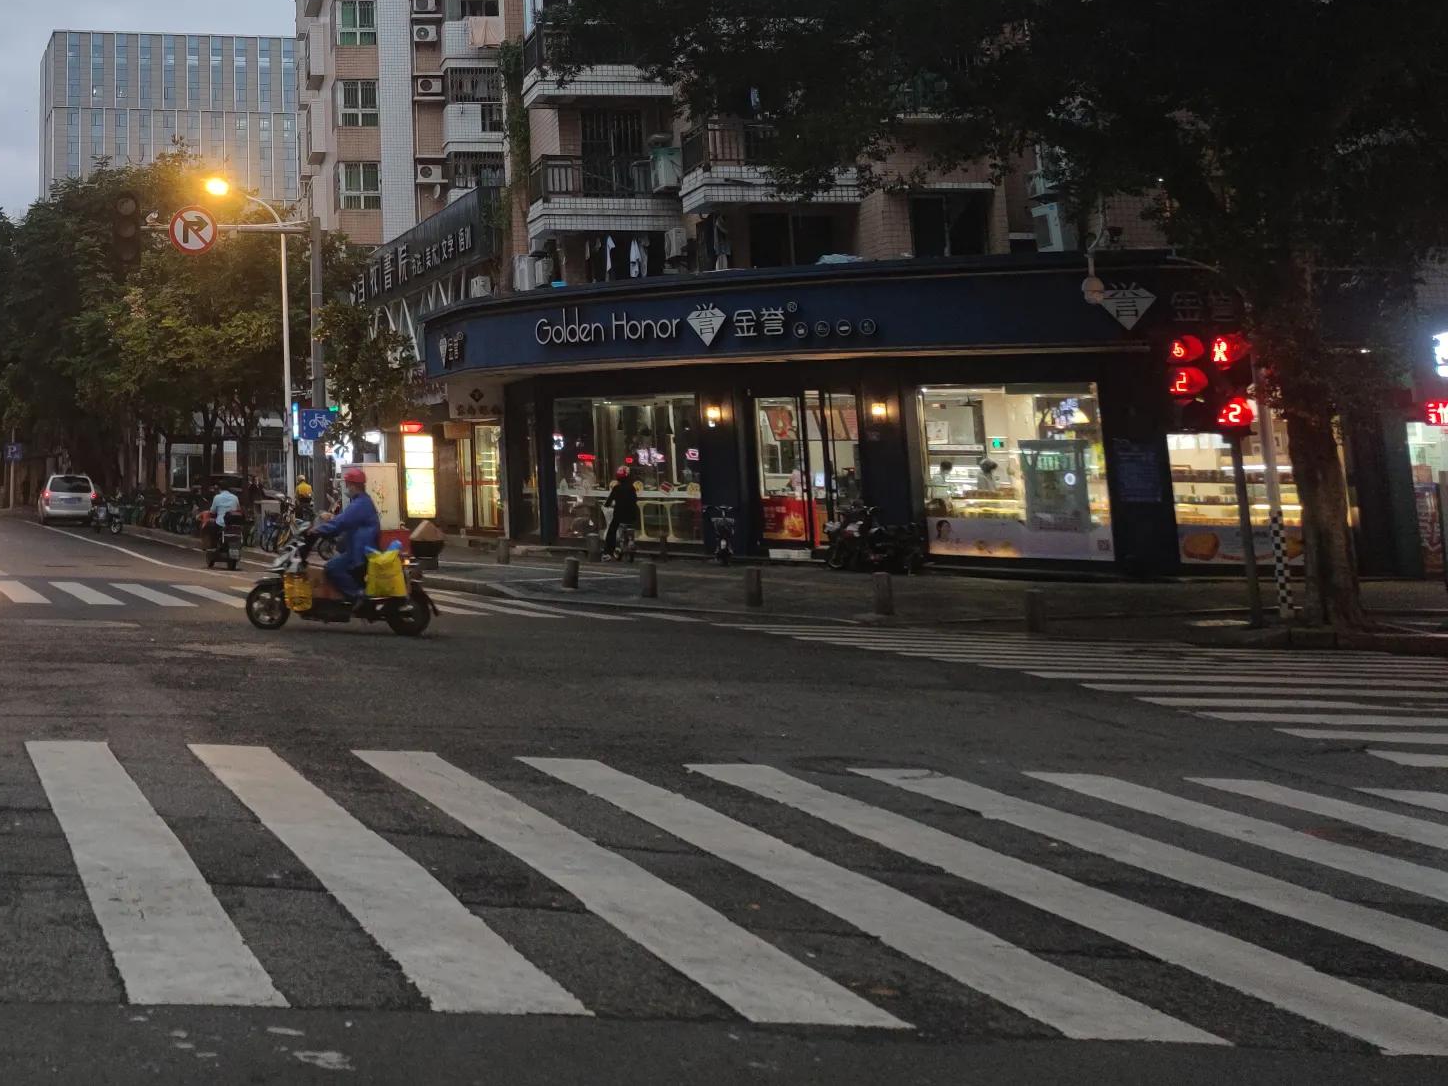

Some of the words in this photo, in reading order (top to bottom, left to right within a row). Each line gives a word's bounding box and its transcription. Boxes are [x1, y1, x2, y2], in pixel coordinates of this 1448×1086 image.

[535, 306, 604, 345] Golden
[612, 311, 680, 341] Honor
[734, 307, 785, 337] 金誉
